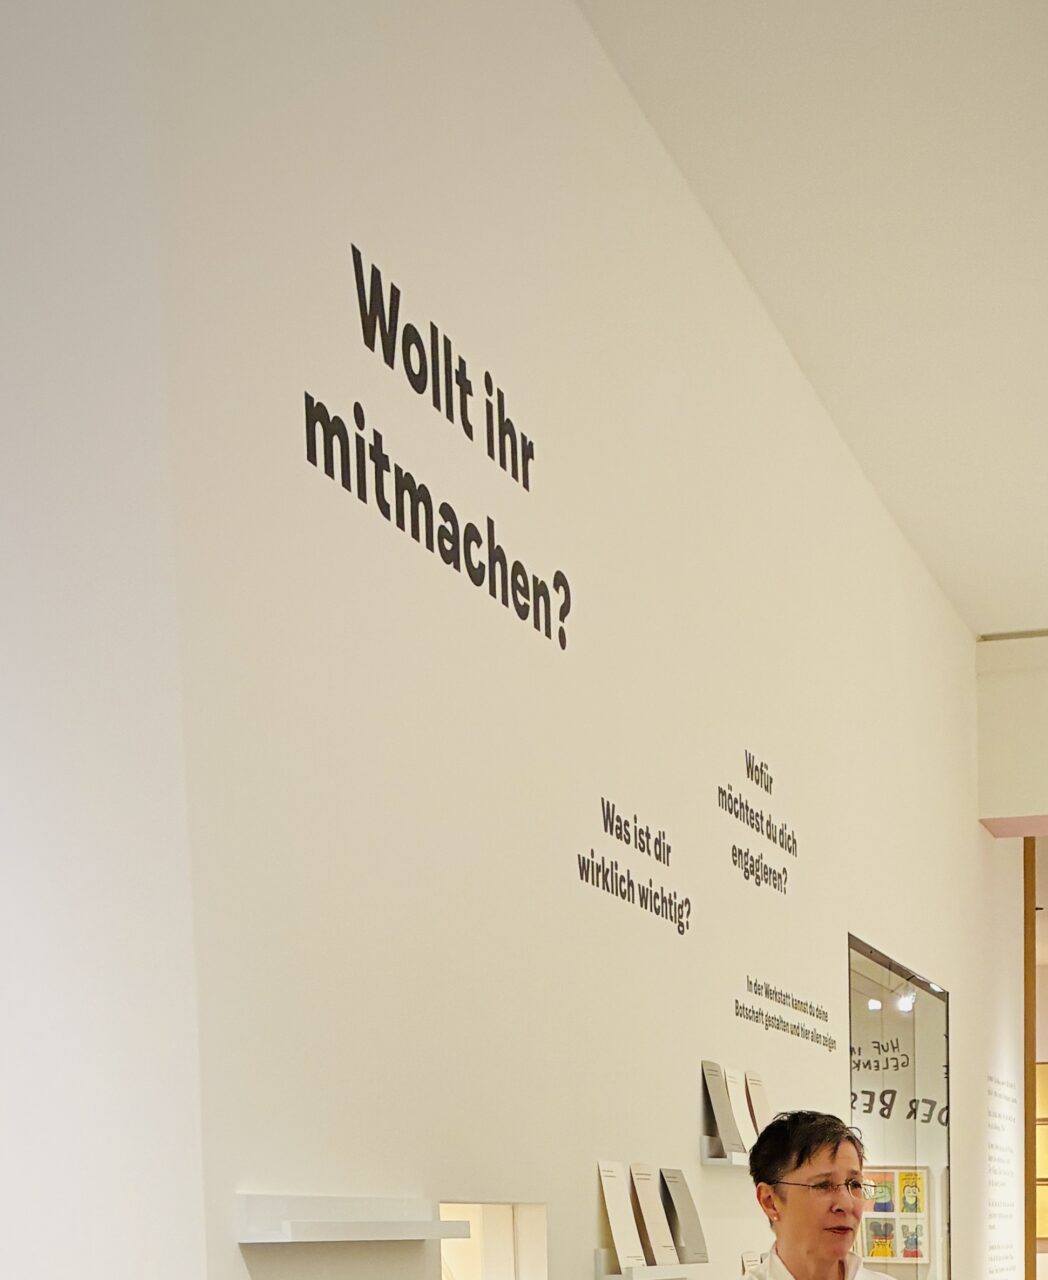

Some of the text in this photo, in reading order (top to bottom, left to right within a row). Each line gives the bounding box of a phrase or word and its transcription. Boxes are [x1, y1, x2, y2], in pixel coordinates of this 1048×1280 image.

[351, 243, 535, 492] Wollt ihr
[304, 390, 571, 650] mitmachen?
[745, 749, 774, 795] Wofür
[601, 796, 671, 867] Was ist dir
[718, 783, 798, 858] möchtest du dich
[577, 848, 691, 936] wirklich wichtig?
[731, 844, 788, 895] engagieren?
[734, 999, 765, 1026] Botschaft
[764, 1011, 790, 1034] gestalten
[789, 1022, 801, 1038] und
[800, 1021, 811, 1041] hier
[746, 974, 828, 1023] In der Werkstatt kannst du deine
